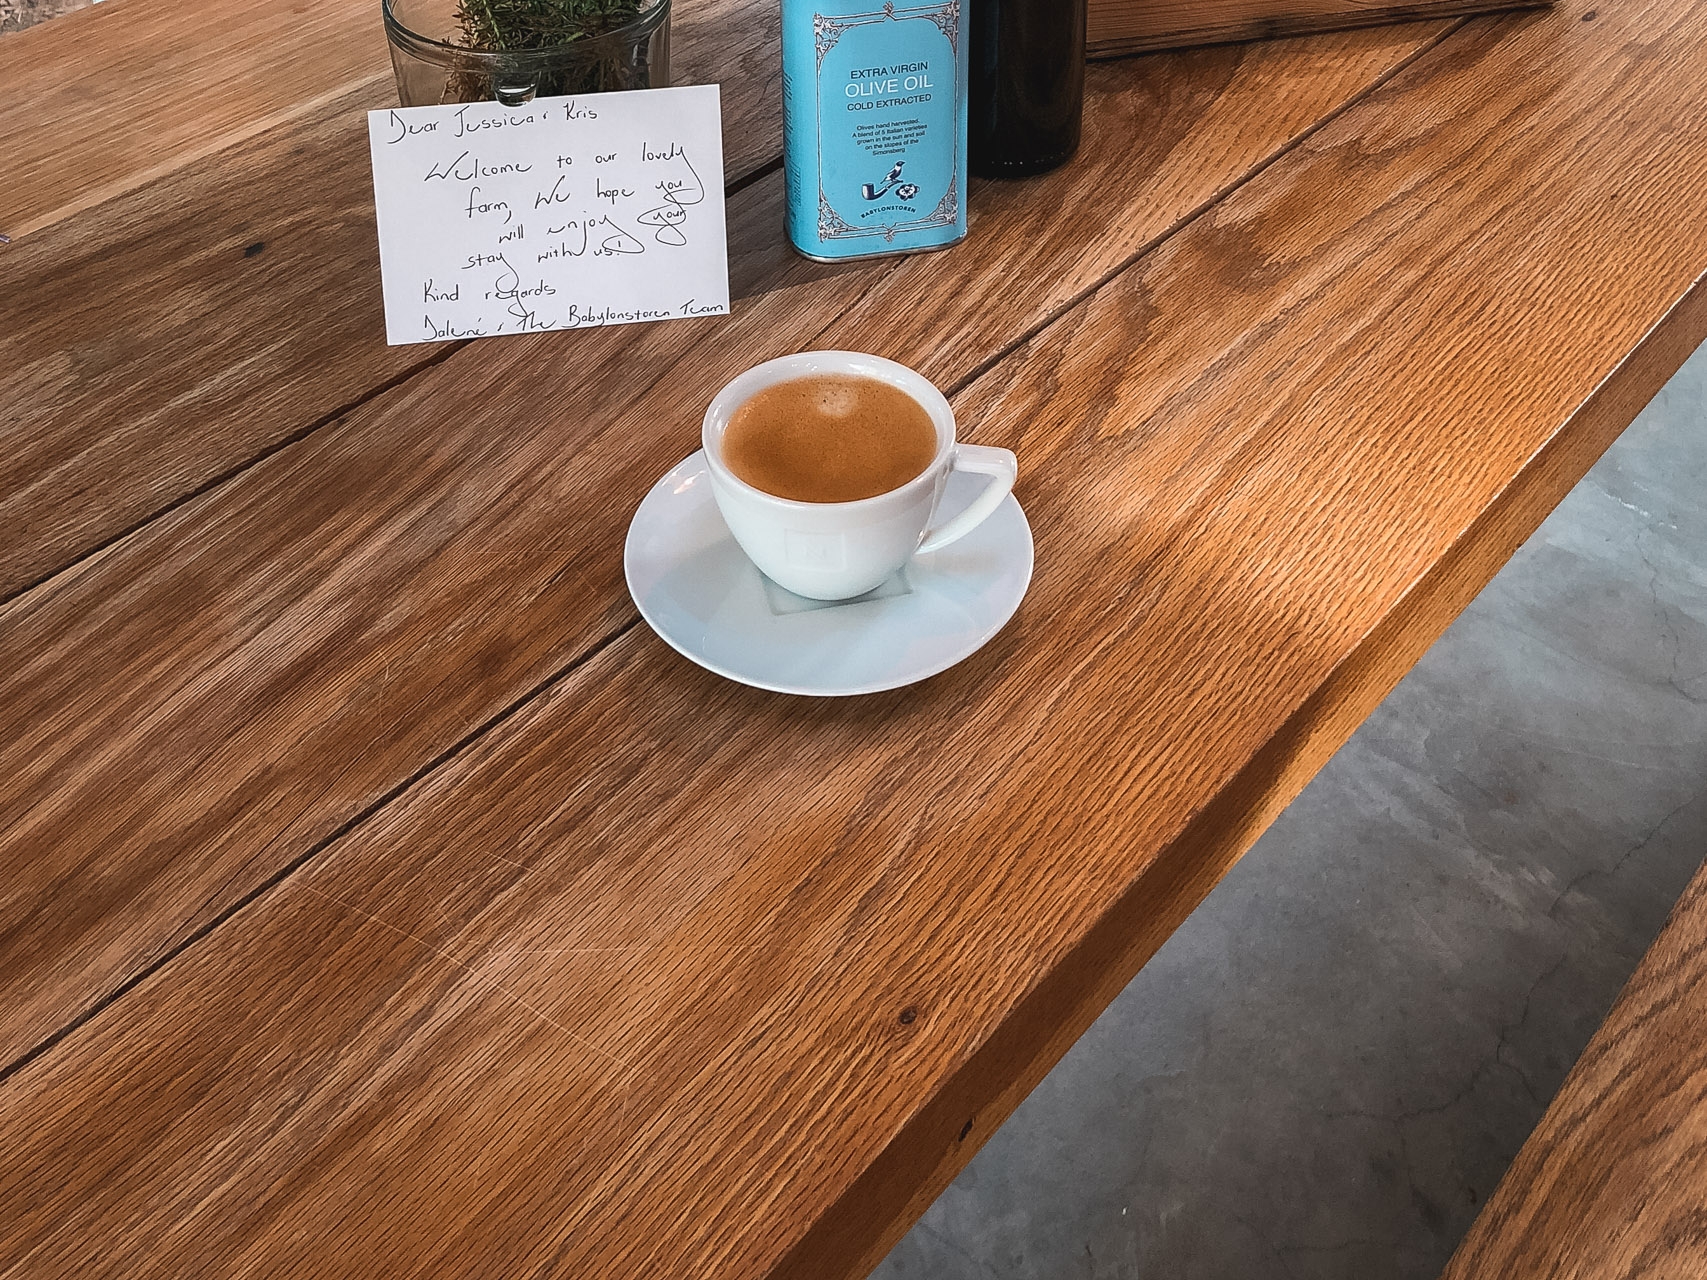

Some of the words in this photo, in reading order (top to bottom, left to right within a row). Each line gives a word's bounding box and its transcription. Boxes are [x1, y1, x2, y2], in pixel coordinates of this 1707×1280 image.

[850, 67, 888, 80] EXTRA
[890, 61, 928, 75] VIRGIN
[845, 79, 899, 98] OLIVE
[904, 75, 934, 91] OIL
[847, 102, 874, 112] COLD
[876, 94, 932, 109] EXTRACTED
[387, 109, 440, 145] Dear
[453, 104, 535, 138] Jessica
[563, 99, 598, 121] Kris
[423, 150, 534, 182] Welcome
[556, 154, 573, 169] to
[594, 152, 617, 164] our
[641, 141, 705, 205] lovely
[596, 177, 636, 205] hope
[860, 205, 917, 219] BABYLONSTOREN
[498, 223, 525, 244] will
[460, 252, 520, 294] stay
[537, 241, 574, 264] with
[423, 278, 460, 304] Kind
[484, 279, 557, 319] regards
[560, 304, 671, 329] Babylonstoren
[679, 298, 725, 316] Team
